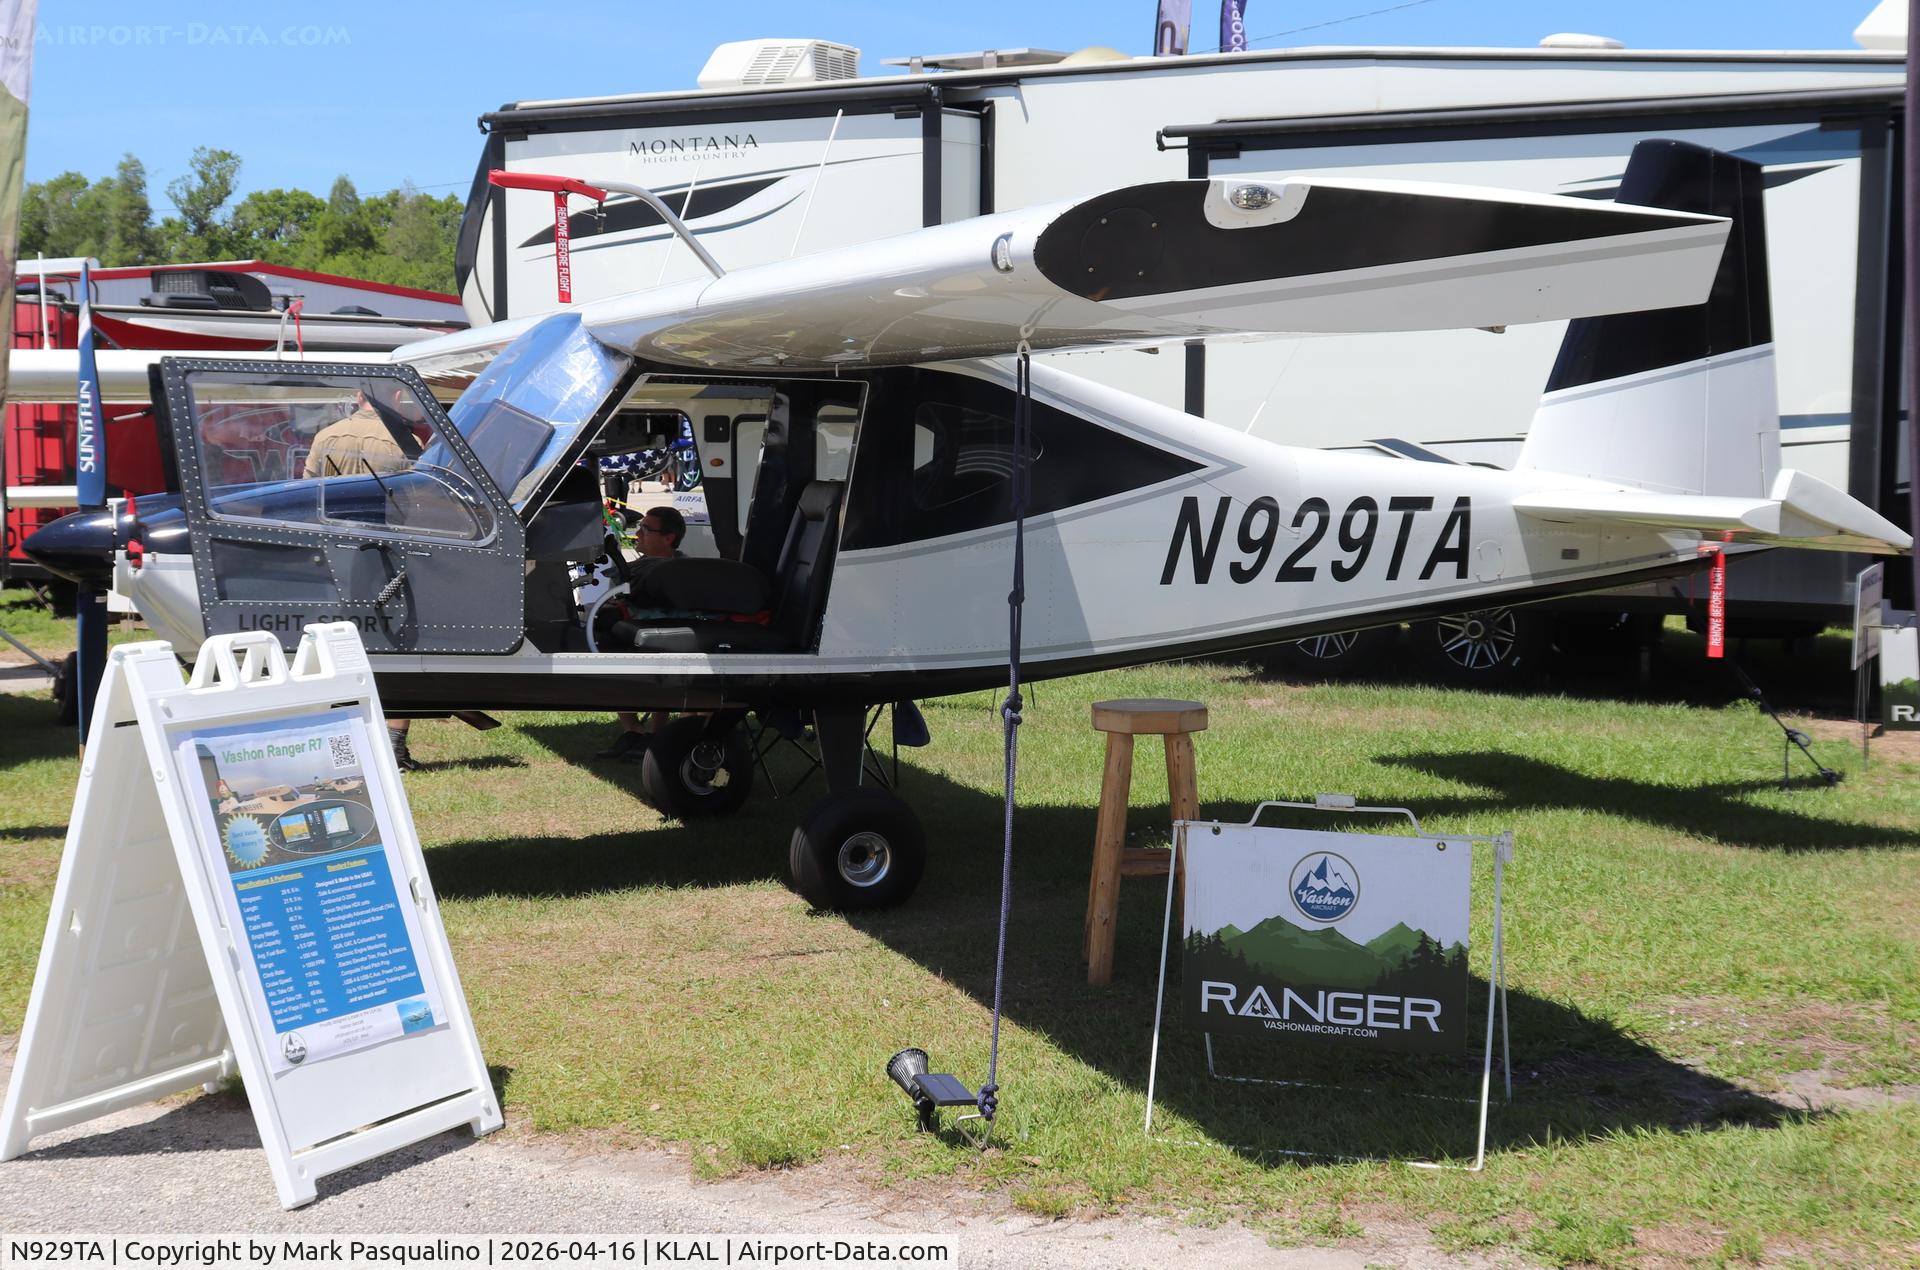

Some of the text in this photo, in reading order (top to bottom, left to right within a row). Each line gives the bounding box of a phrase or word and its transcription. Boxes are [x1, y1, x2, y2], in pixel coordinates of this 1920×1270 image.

[629, 134, 759, 156] MONTANA
[643, 151, 748, 164] HIGH COUNTRY
[556, 206, 570, 293] REMOVE BEFORE FLIGHT
[79, 380, 92, 416] FUN
[79, 435, 96, 473] SUN
[675, 495, 704, 503] AIRFA
[1159, 495, 1471, 585] N929TA
[1713, 590, 1722, 617] BEFORE
[239, 614, 304, 632] LIGHT
[1711, 616, 1721, 647] REMOVE
[222, 738, 322, 763] Vashon Ranger R7
[1298, 889, 1351, 906] Vashon
[1201, 980, 1442, 1033] RANGER
[1263, 1020, 1378, 1039] VASHONAIRCRAFT.COM
